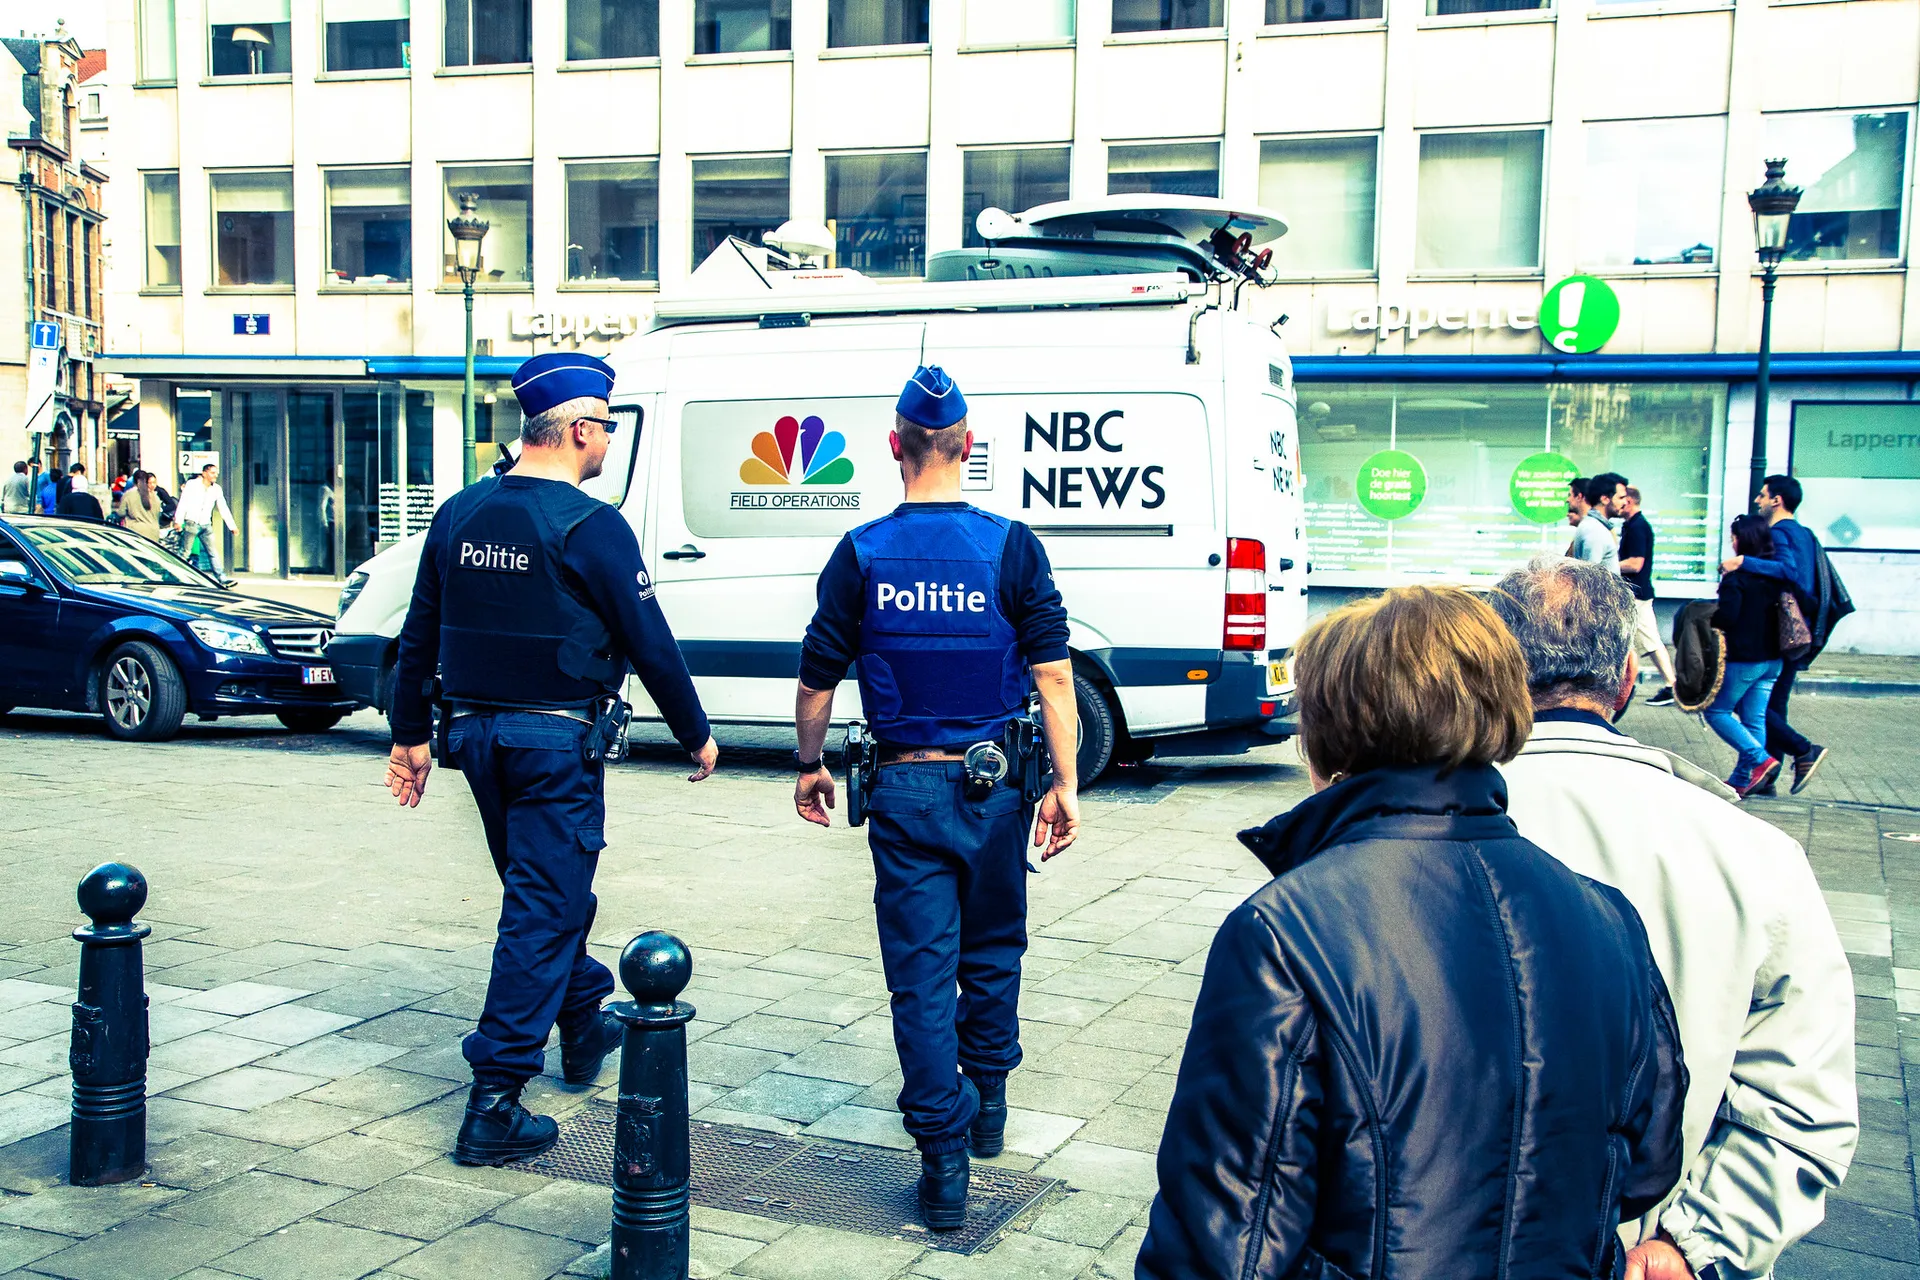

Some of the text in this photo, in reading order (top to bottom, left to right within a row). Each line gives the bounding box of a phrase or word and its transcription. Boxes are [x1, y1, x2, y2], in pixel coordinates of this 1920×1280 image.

[1328, 296, 1541, 339] Lapperre
[1024, 410, 1124, 453] NBC
[1827, 430, 1920, 451] Lapperr
[182, 453, 190, 466] 2
[1371, 467, 1412, 478] Doe hier
[1022, 465, 1166, 509] NEWS
[1369, 490, 1411, 500] hoortest
[1370, 479, 1411, 491] de gratis
[731, 495, 860, 507] FIELD OPERATIONS
[459, 541, 529, 571] Politie
[877, 581, 986, 612] Politie
